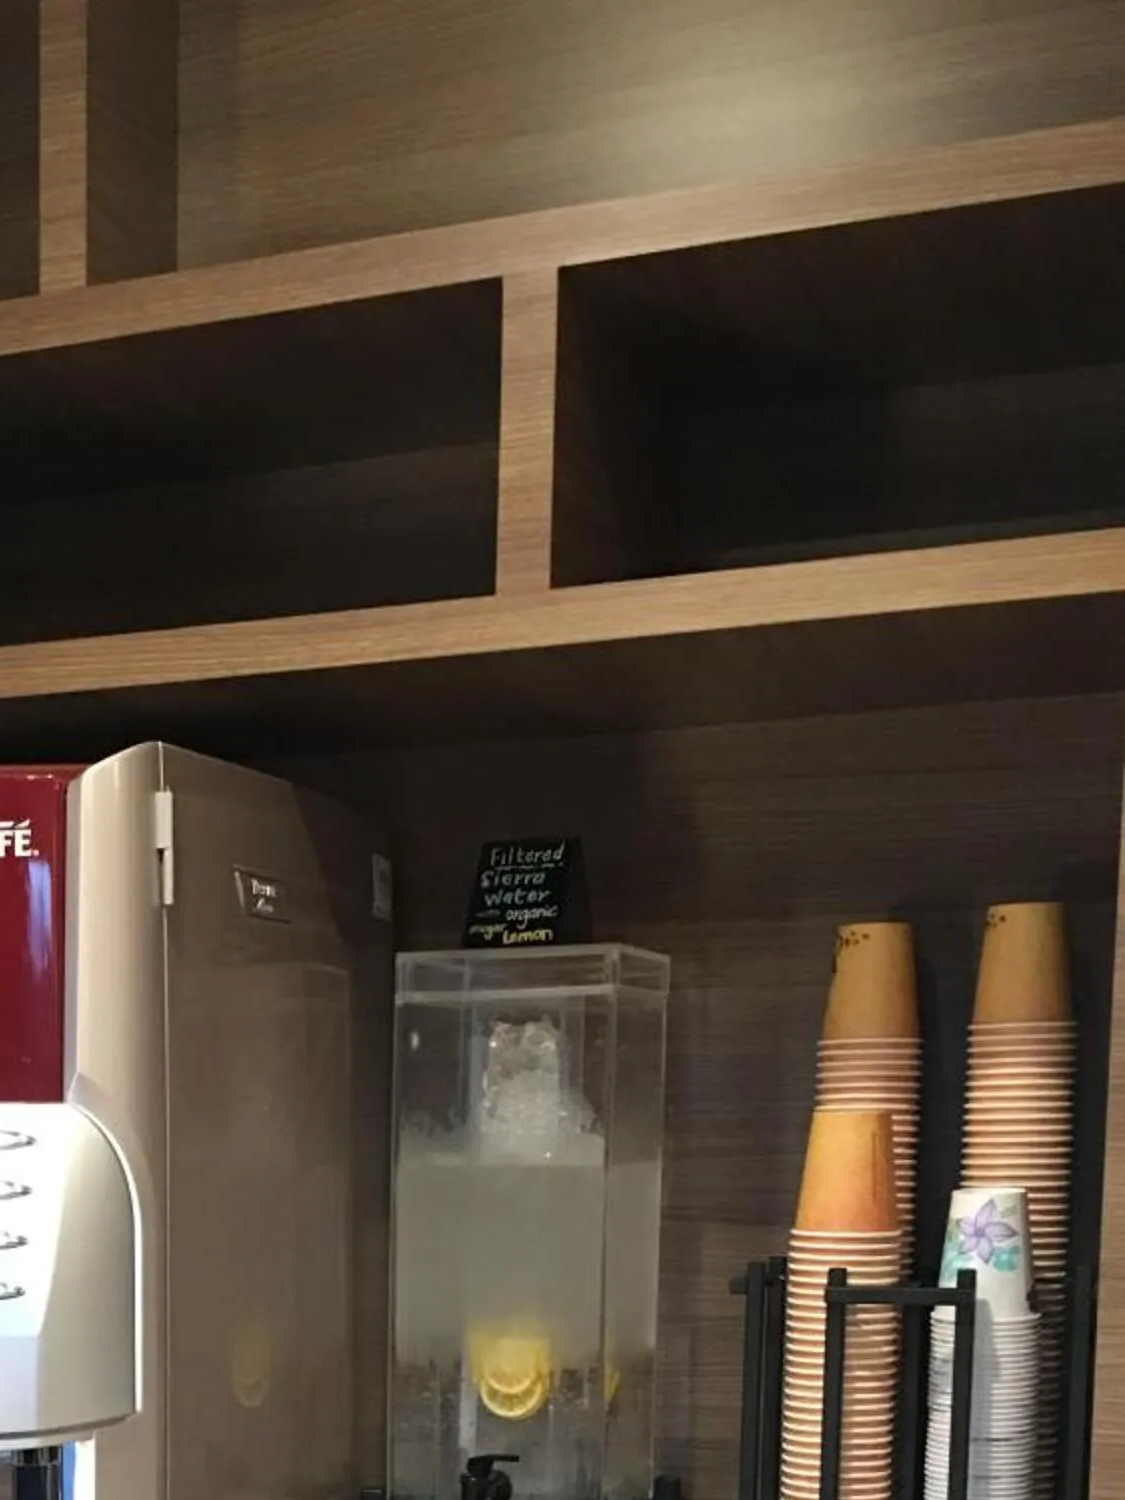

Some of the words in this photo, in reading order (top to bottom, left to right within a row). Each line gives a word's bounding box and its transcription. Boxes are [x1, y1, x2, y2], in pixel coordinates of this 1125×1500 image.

[490, 840, 565, 866] Filtered
[480, 869, 546, 888] Sierra
[505, 905, 559, 930] organic
